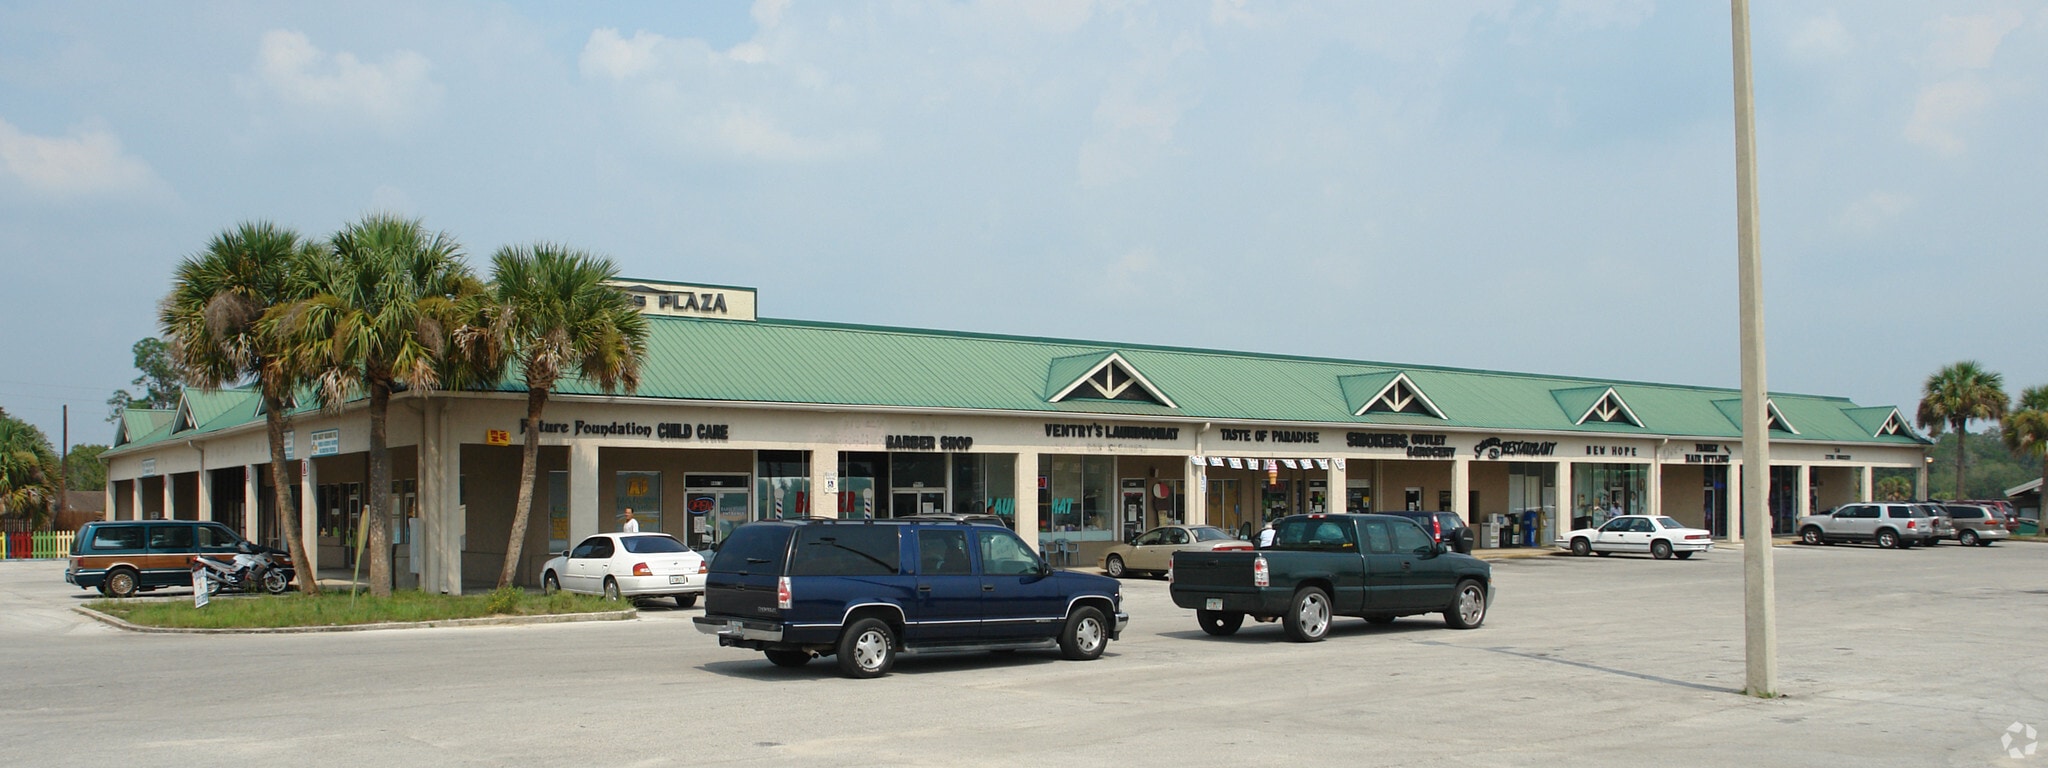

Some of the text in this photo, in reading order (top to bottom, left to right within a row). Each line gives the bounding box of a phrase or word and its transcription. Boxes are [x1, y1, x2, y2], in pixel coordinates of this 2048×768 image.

[659, 293, 727, 313] PLAZA
[520, 418, 728, 440] Fture Foundation CHILD CARE
[1045, 423, 1179, 440] VENTRY'S LAUNDROMAT
[1220, 428, 1319, 443] TASTE OF PARADISE
[886, 435, 973, 450] BARBER SHOP
[1346, 432, 1446, 448] SMOKERS OUTLET
[1501, 441, 1557, 456] RESTAURANT
[1612, 446, 1637, 457] HOPE
[688, 499, 713, 511] OPEN
